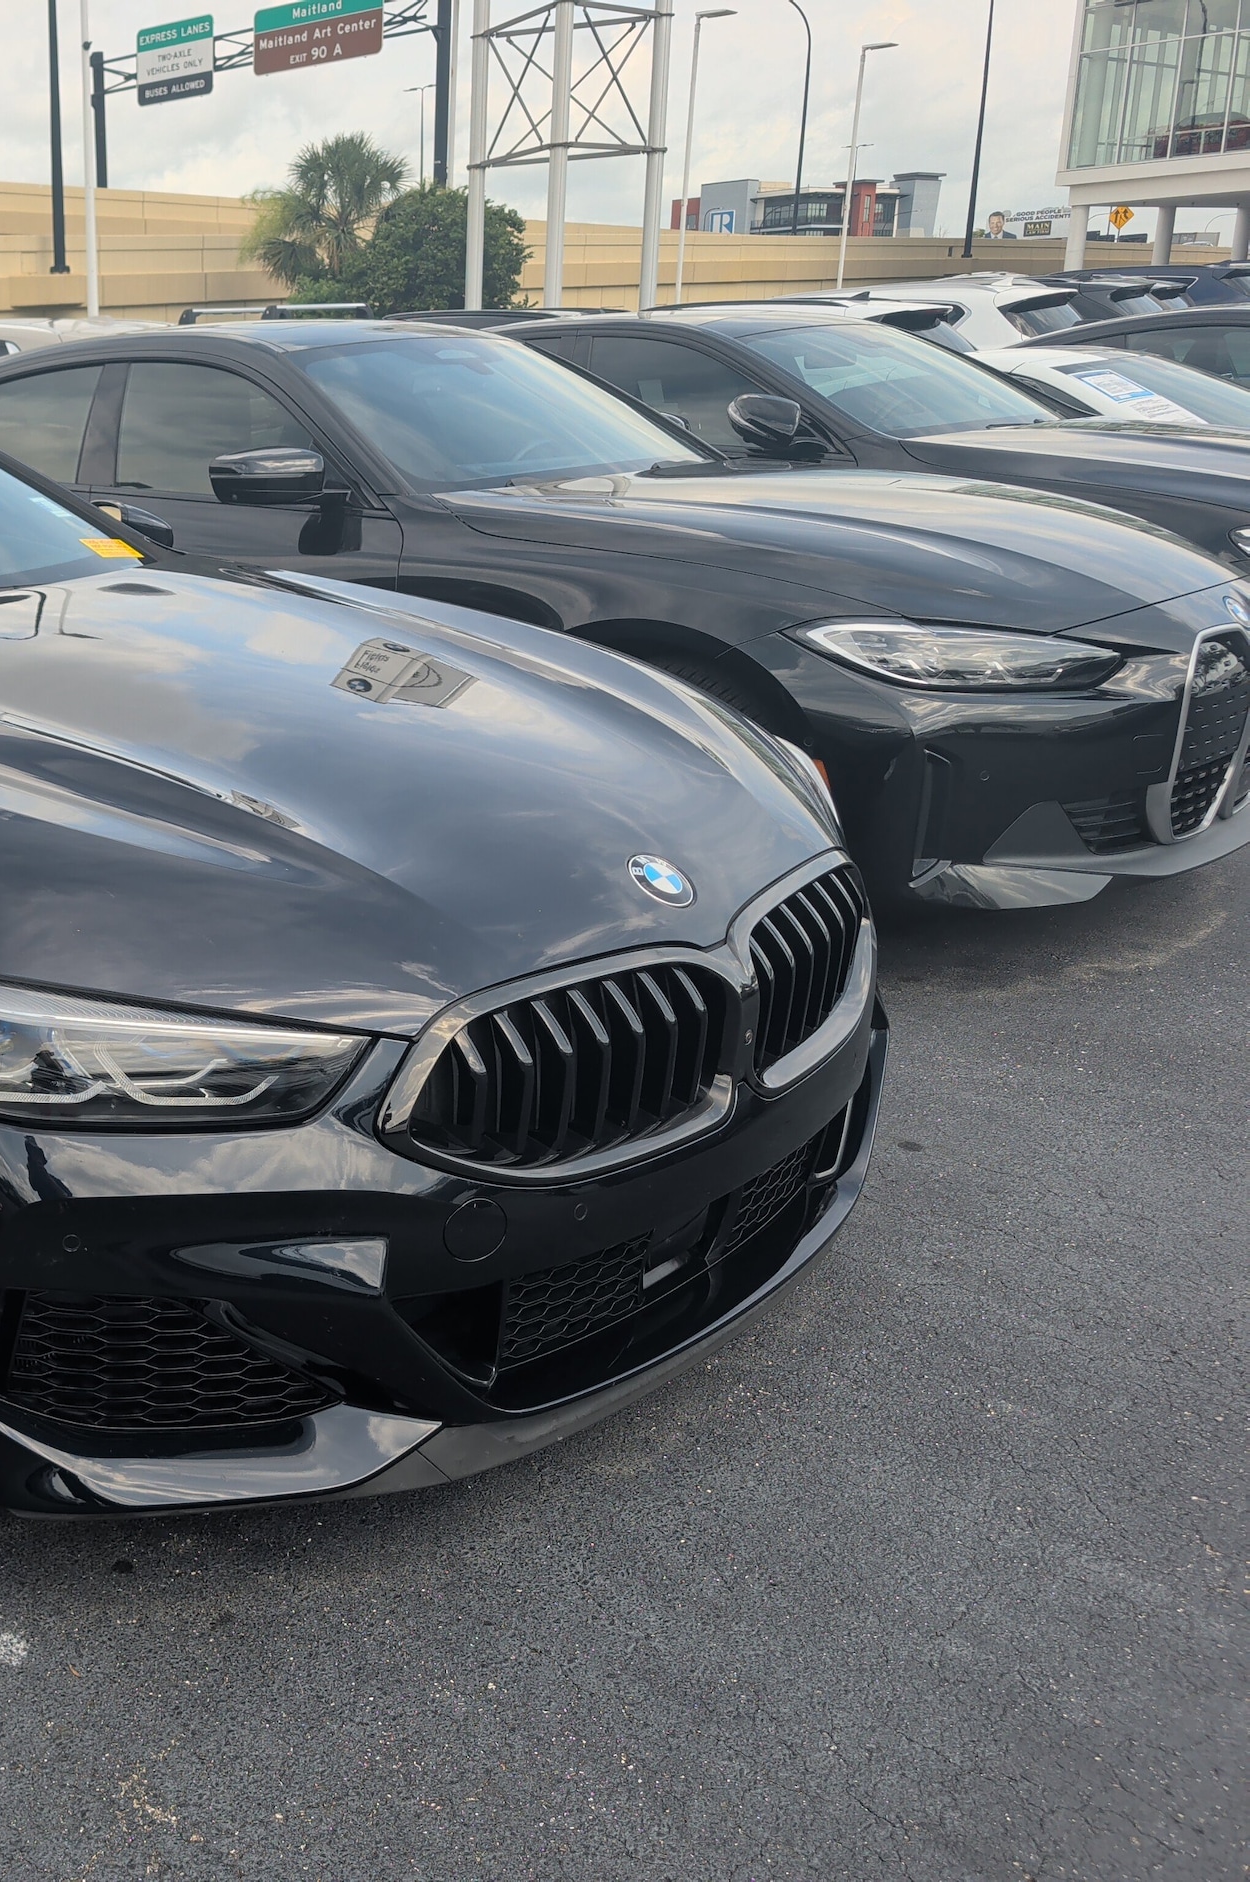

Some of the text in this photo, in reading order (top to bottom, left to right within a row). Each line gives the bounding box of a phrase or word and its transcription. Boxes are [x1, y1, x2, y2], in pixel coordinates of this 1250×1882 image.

[292, 0, 342, 19] Maitland
[139, 22, 210, 46] EXPRESS LANES
[259, 19, 376, 50] Maitland Art Center
[158, 48, 193, 62] TWO-AXLE
[290, 43, 342, 64] EXIT 90 A
[146, 57, 203, 76] VEHICLES ONLY
[144, 79, 205, 98] BUSES ALLOWED
